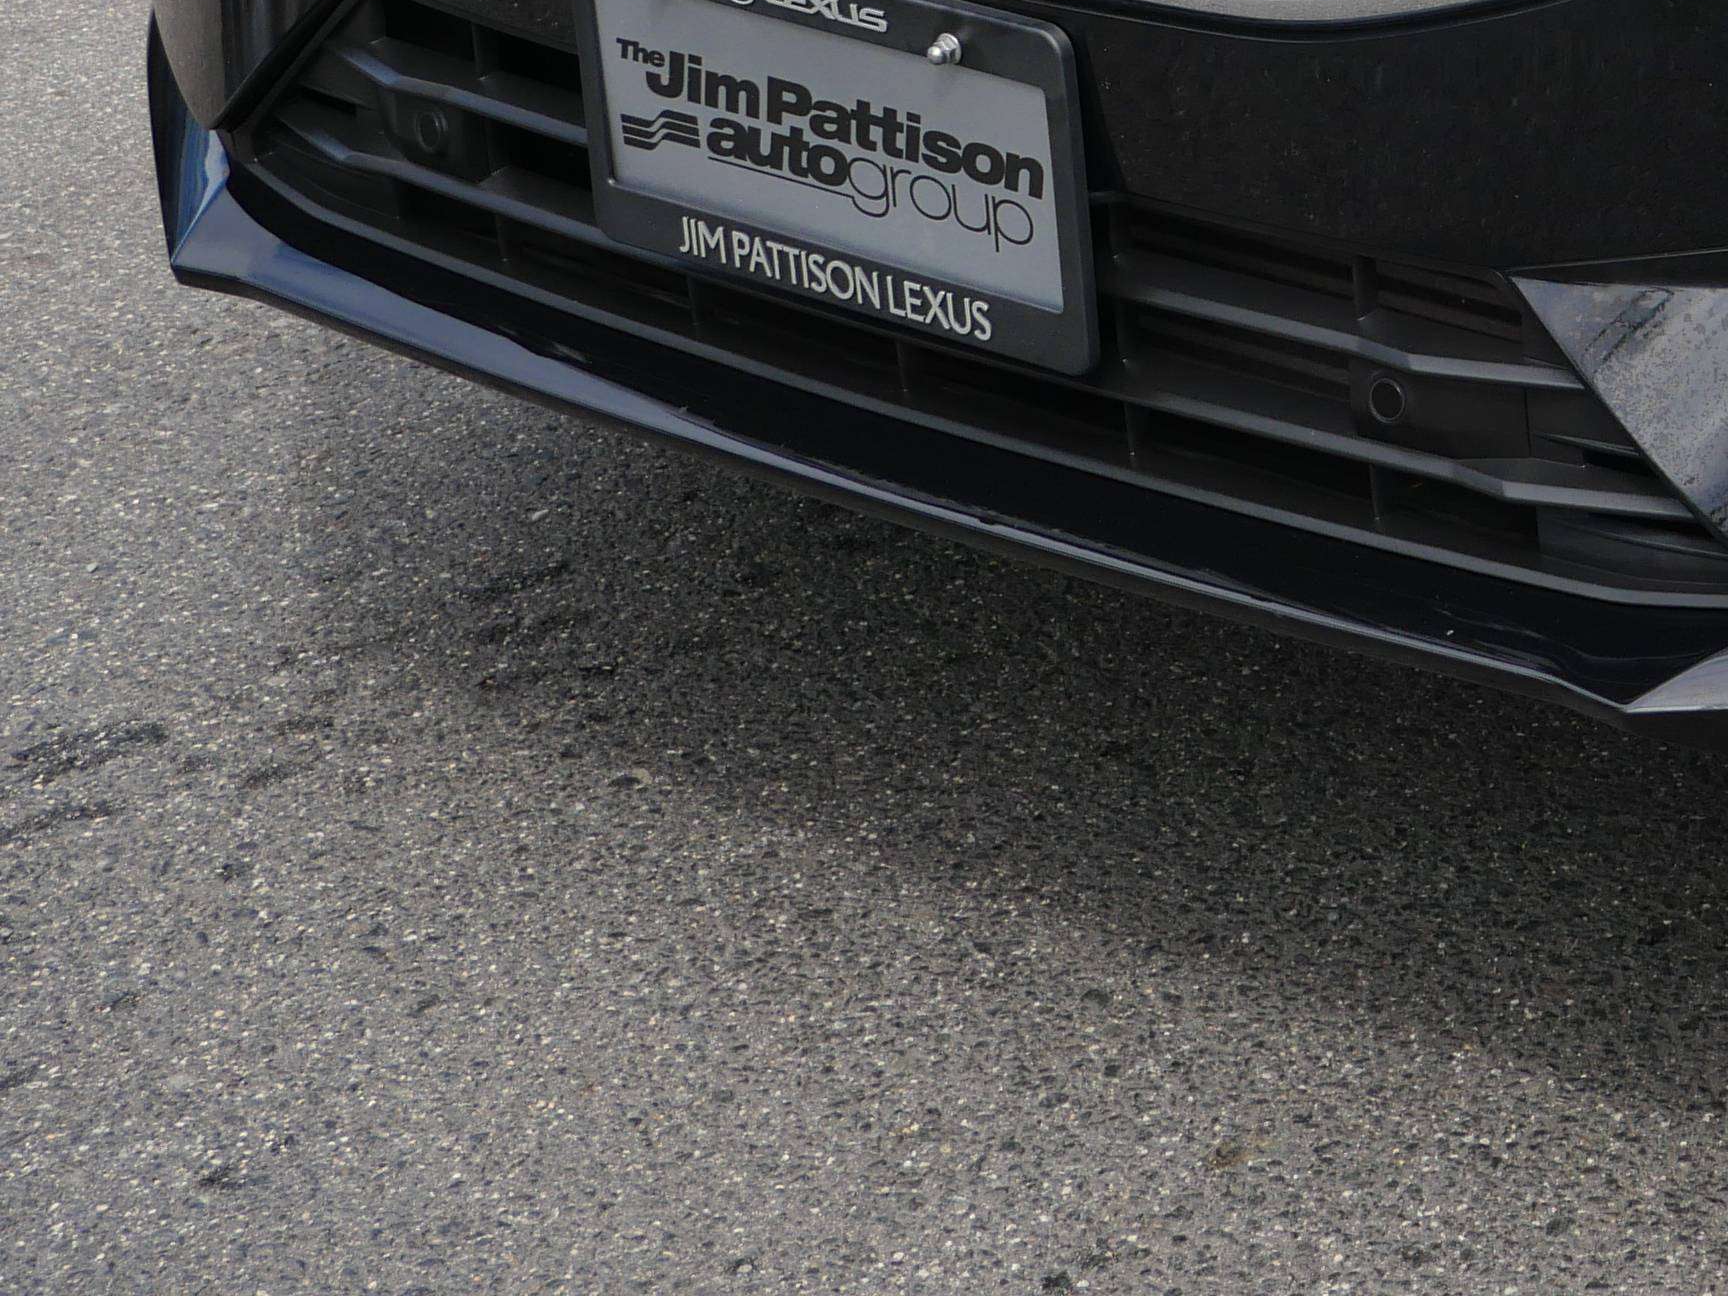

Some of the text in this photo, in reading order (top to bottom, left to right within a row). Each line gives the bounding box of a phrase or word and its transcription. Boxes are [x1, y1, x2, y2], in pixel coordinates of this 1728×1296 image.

[616, 37, 1045, 200] The Jim Pattison
[706, 116, 1034, 253] autogroup
[679, 216, 993, 341] JIM PATTISON LEXUS
